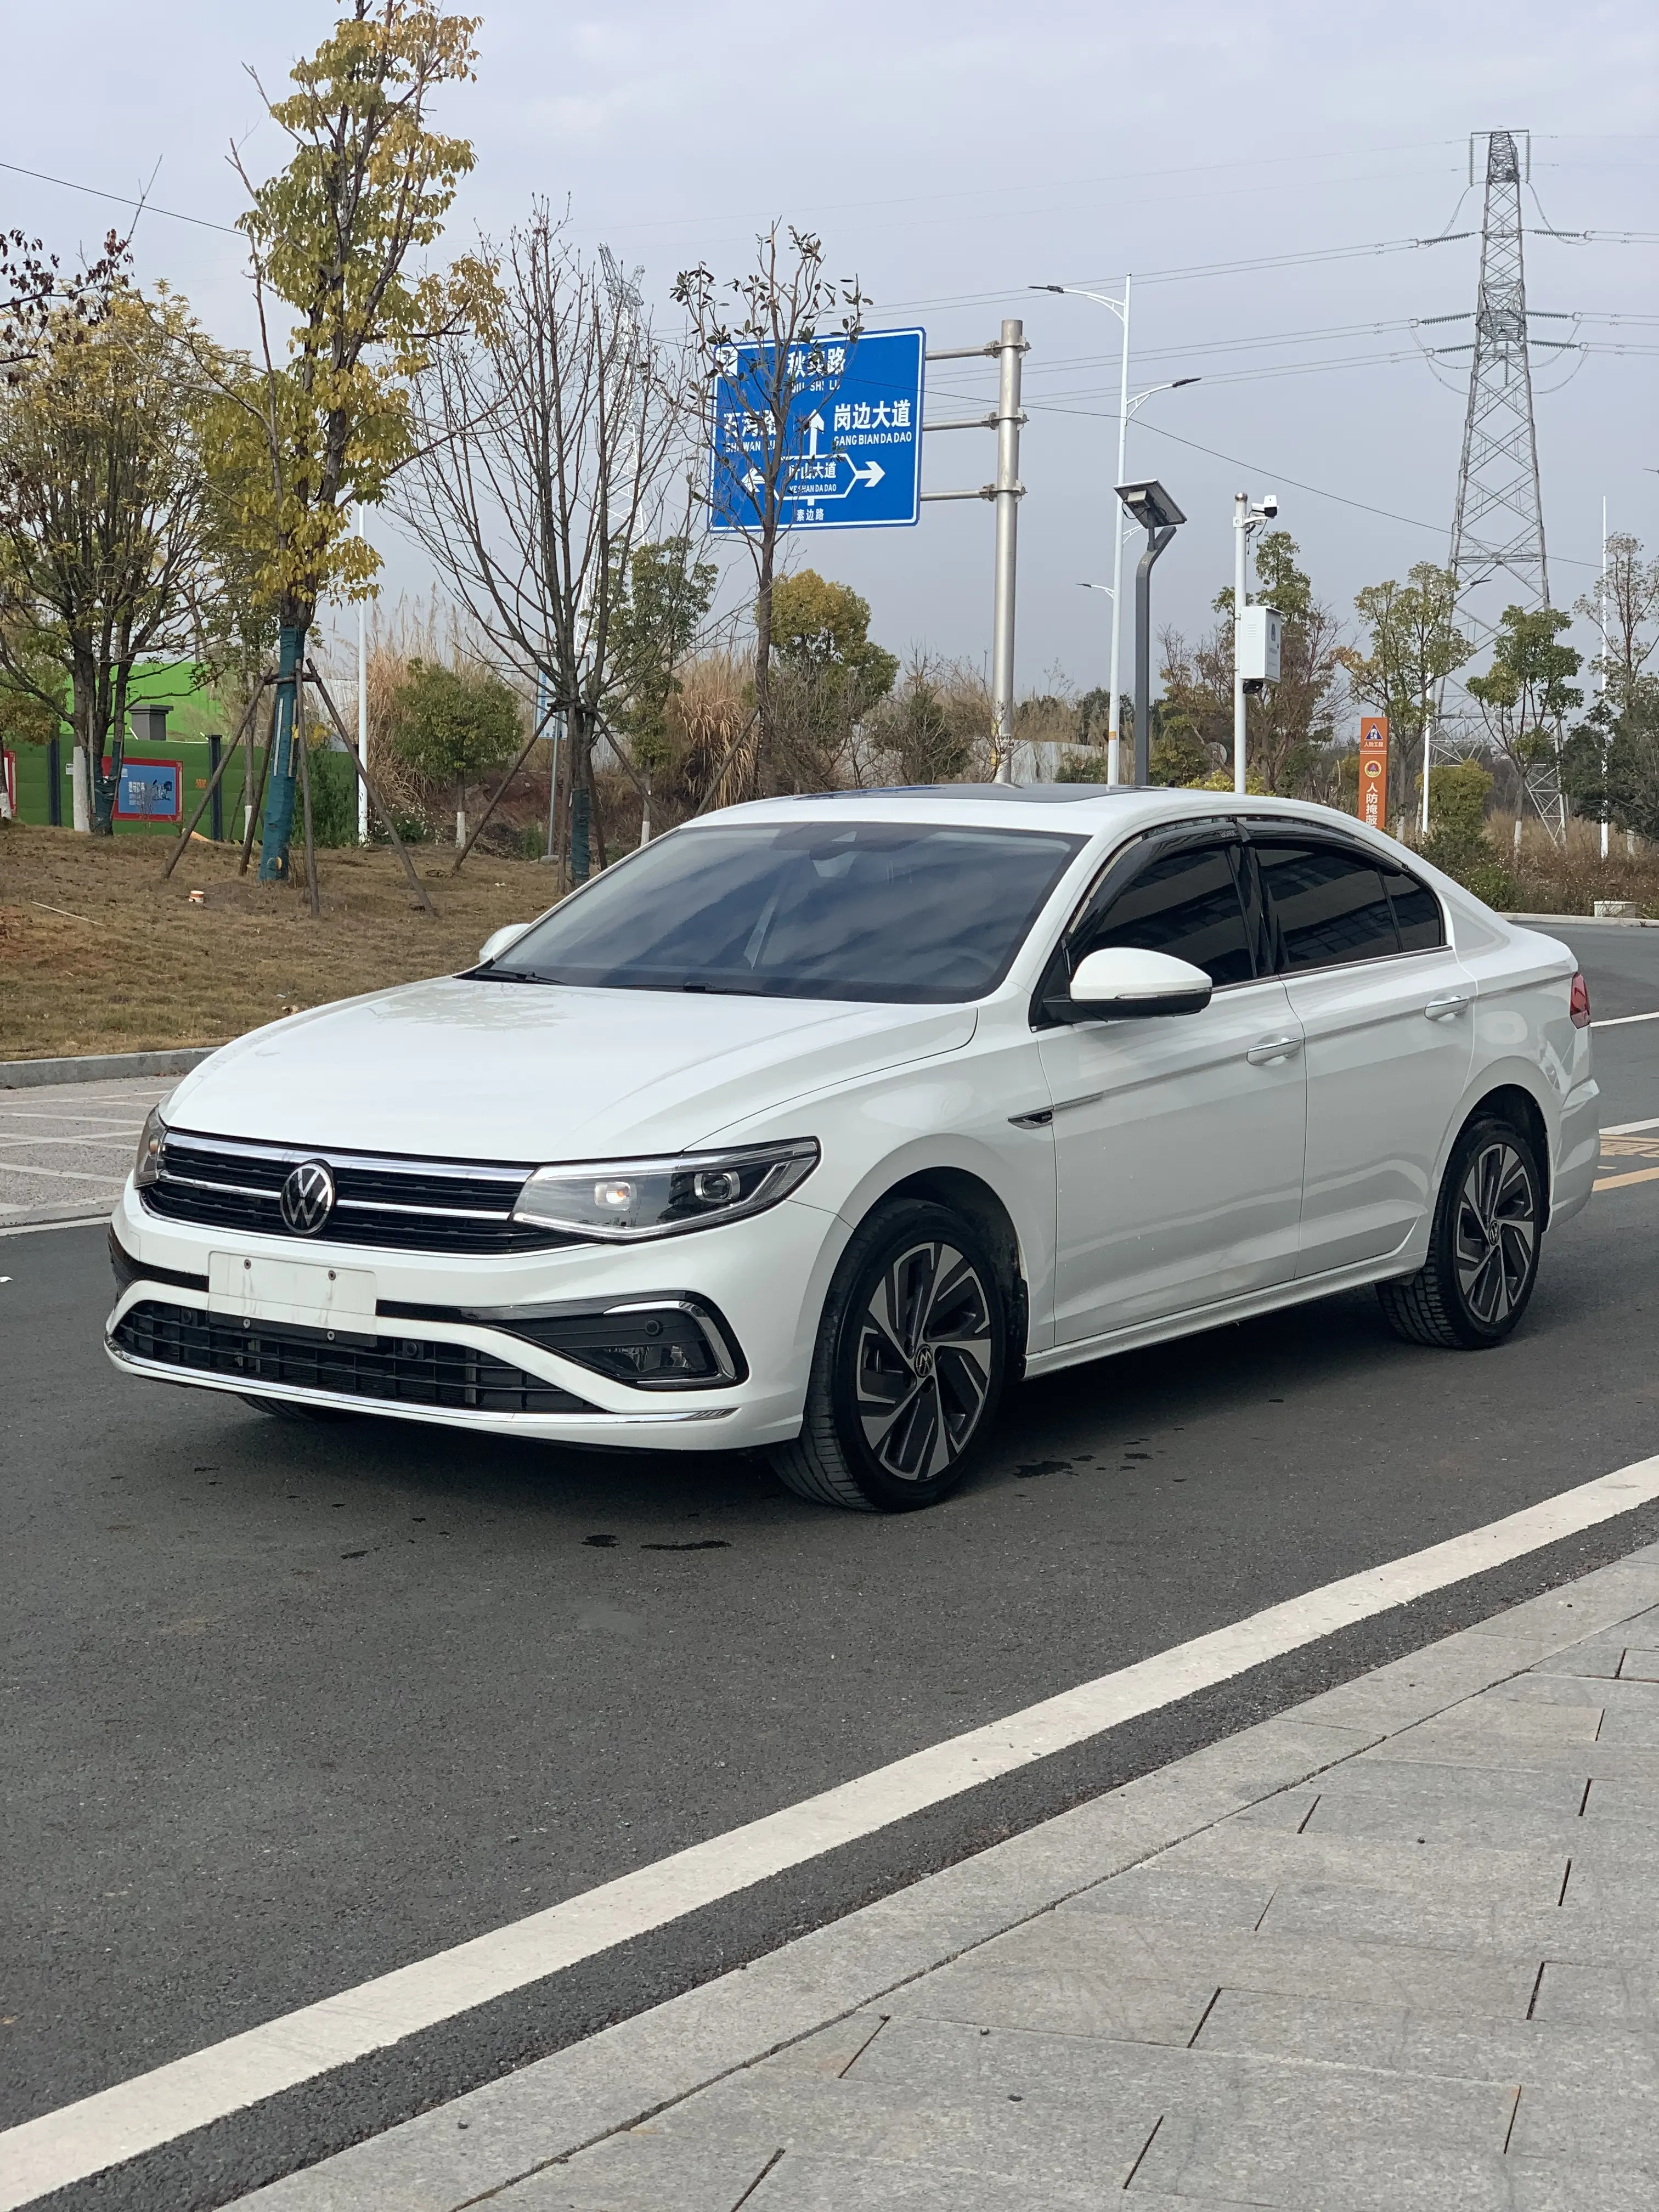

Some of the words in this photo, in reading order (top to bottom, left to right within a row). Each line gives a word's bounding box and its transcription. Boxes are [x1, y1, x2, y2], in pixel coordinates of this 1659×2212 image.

[810, 380, 824, 392] SHI
[829, 379, 840, 390] LU
[834, 399, 911, 432] 岗边大道
[743, 441, 761, 452] WAN
[765, 439, 776, 450] U
[834, 435, 857, 446] GANG
[859, 432, 879, 445] BIAN
[881, 432, 893, 444] DA
[894, 431, 912, 443] DAO
[824, 483, 837, 492] DAO
[797, 508, 824, 522] 素边路
[1366, 782, 1378, 827] 人防掩蔽
